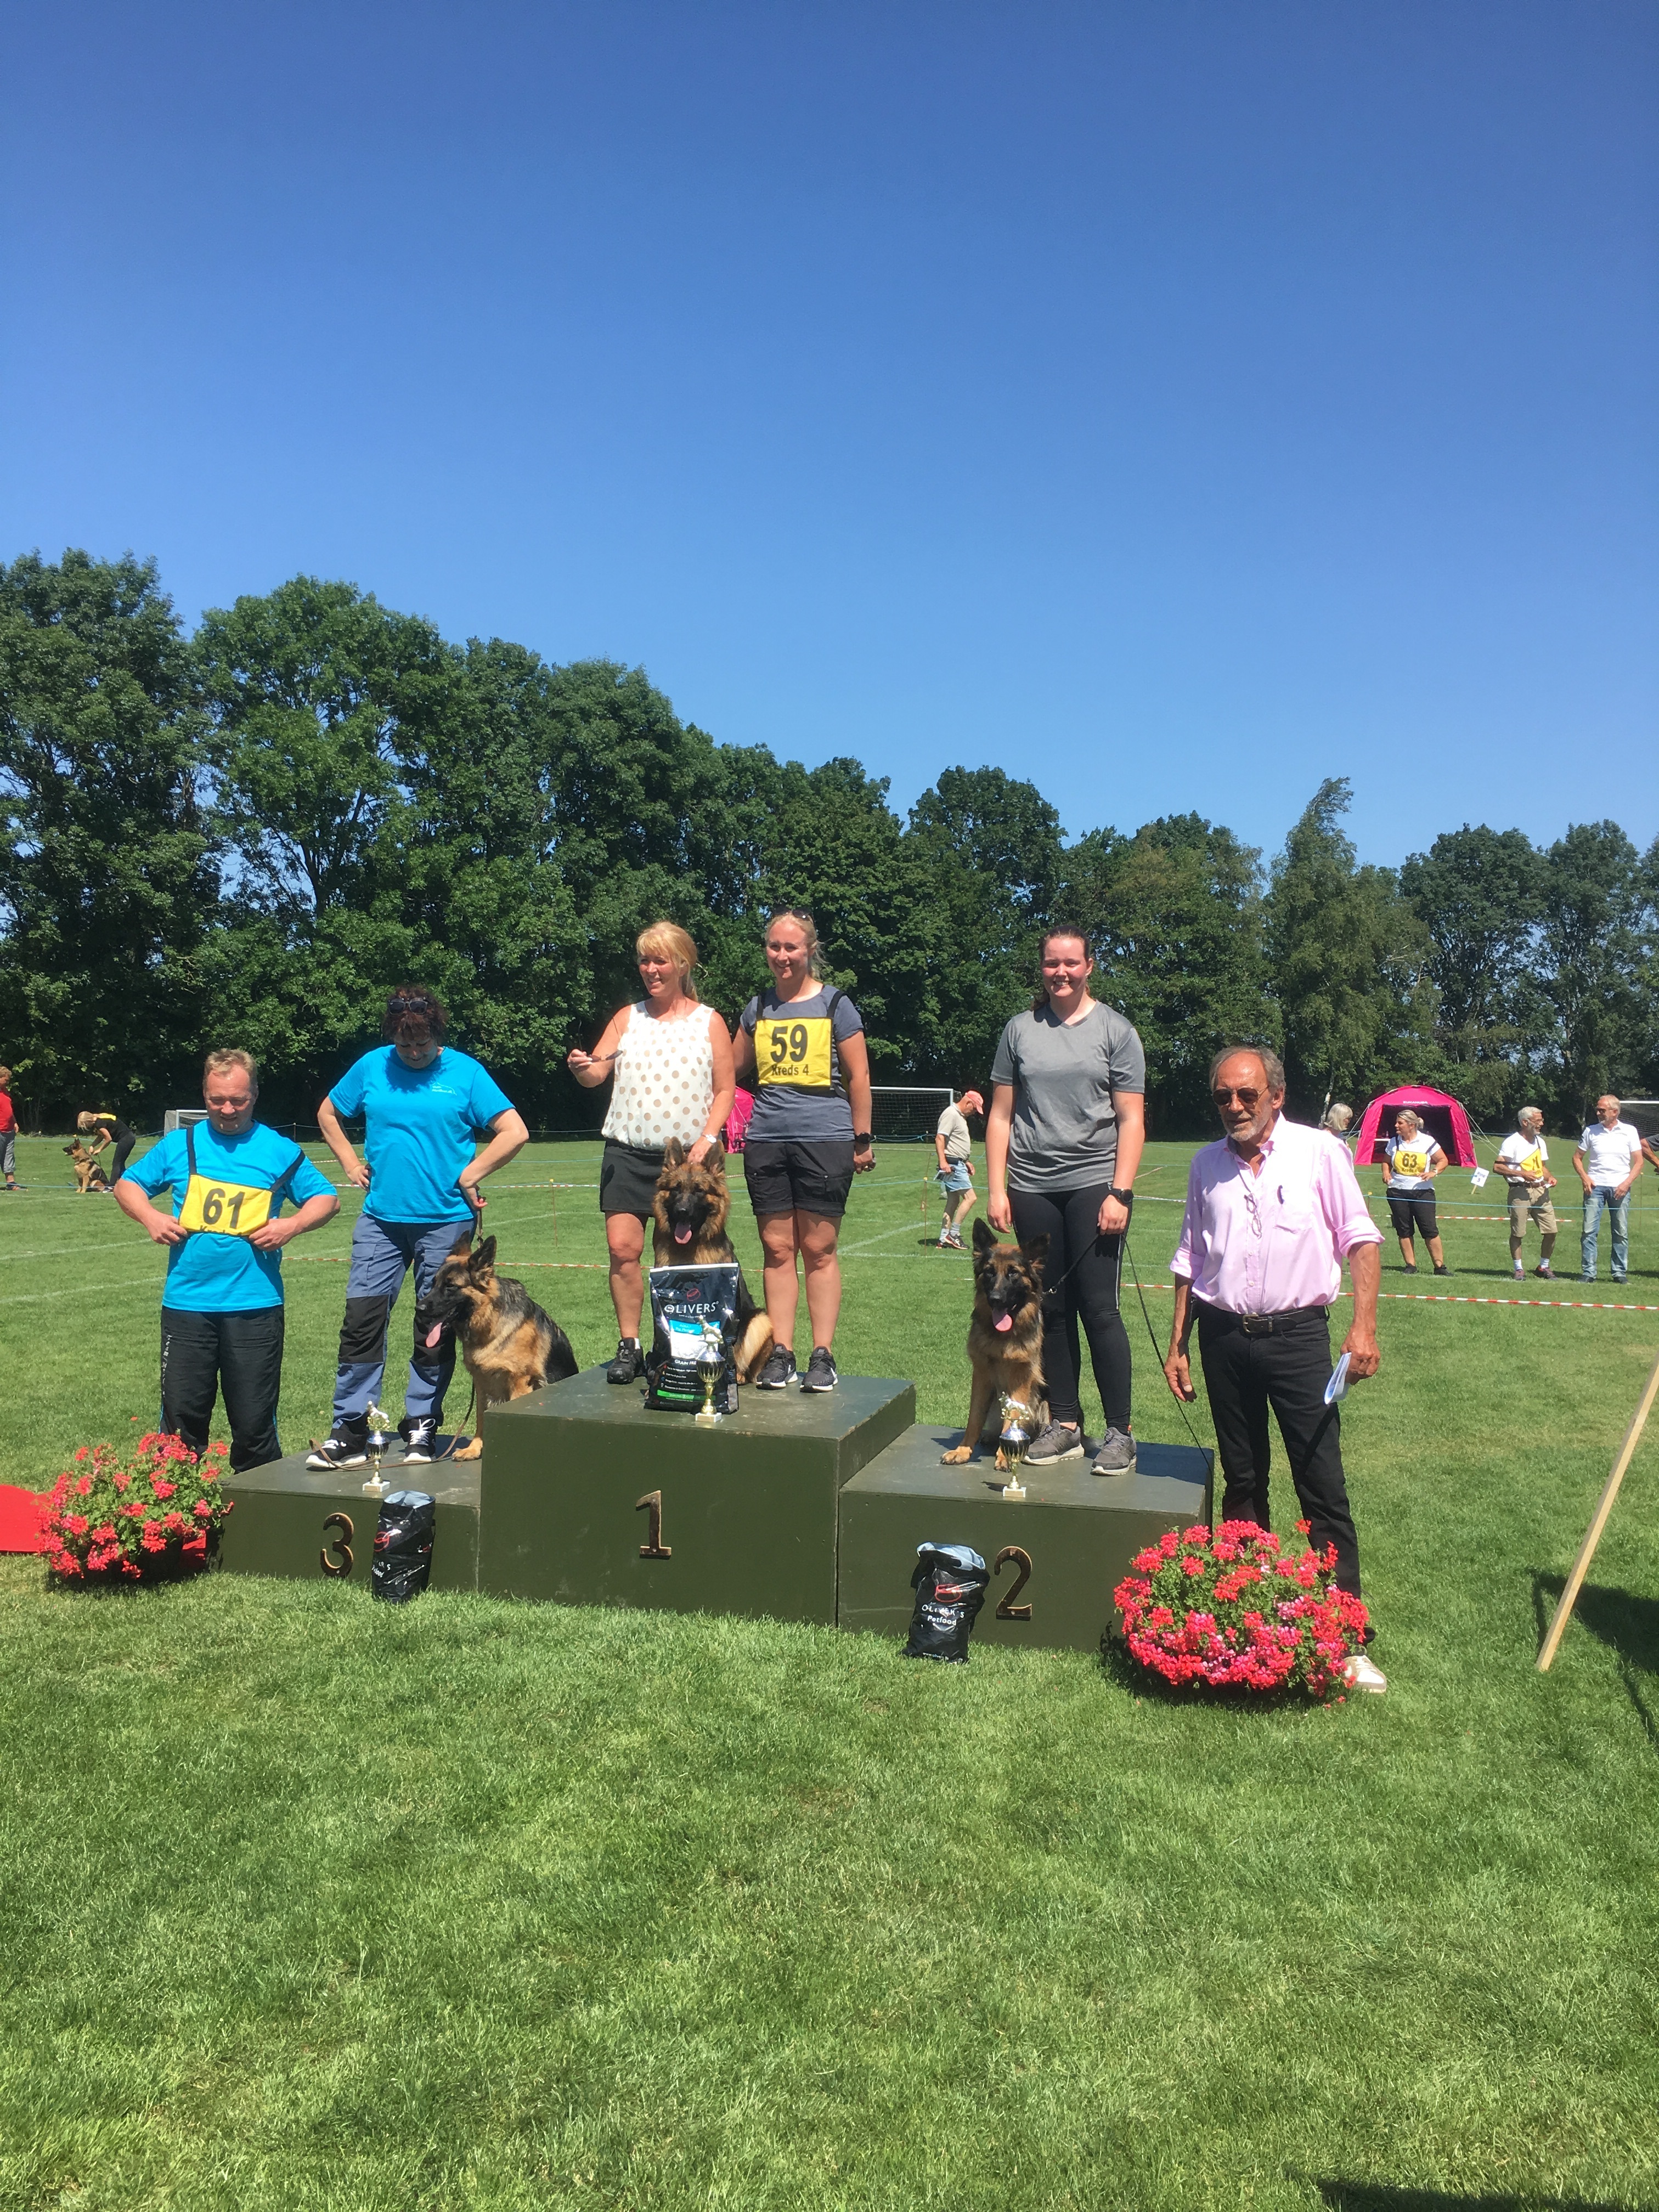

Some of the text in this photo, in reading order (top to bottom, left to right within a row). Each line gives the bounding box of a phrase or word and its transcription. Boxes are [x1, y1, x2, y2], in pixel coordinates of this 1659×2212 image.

[770, 1024, 808, 1063] 59
[771, 1064, 809, 1076] Kreds 4
[1402, 1153, 1417, 1168] 63
[203, 1188, 245, 1229] 61
[636, 1490, 672, 1558] 1
[320, 1513, 354, 1578] 3
[994, 1546, 1032, 1621] 2
[927, 1615, 957, 1626] Petfood
